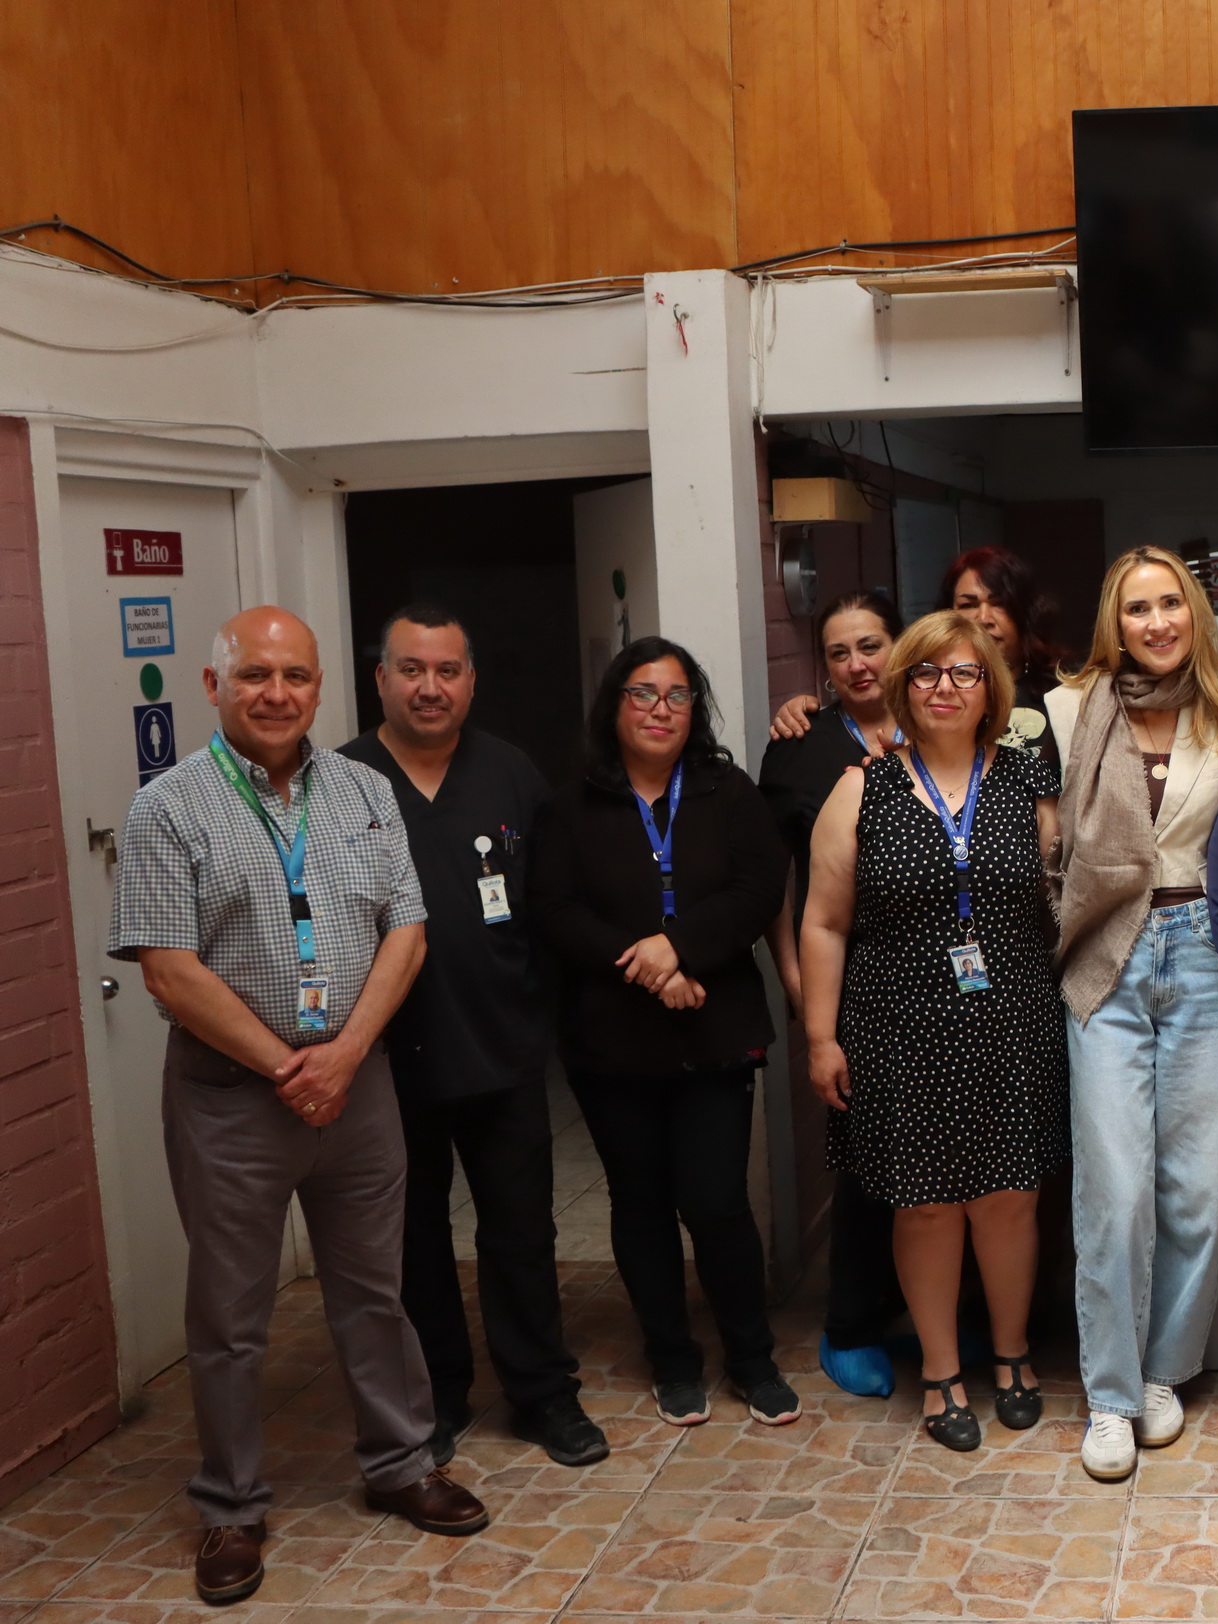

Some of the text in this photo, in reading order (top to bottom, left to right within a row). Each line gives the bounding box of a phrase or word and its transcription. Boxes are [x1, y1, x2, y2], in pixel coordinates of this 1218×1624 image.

[133, 538, 169, 563] Baño
[134, 606, 159, 617] BAÑO DE
[127, 620, 168, 631] FUNCIONARIAS
[137, 635, 156, 645] MUJER
[218, 752, 238, 781] Quillota
